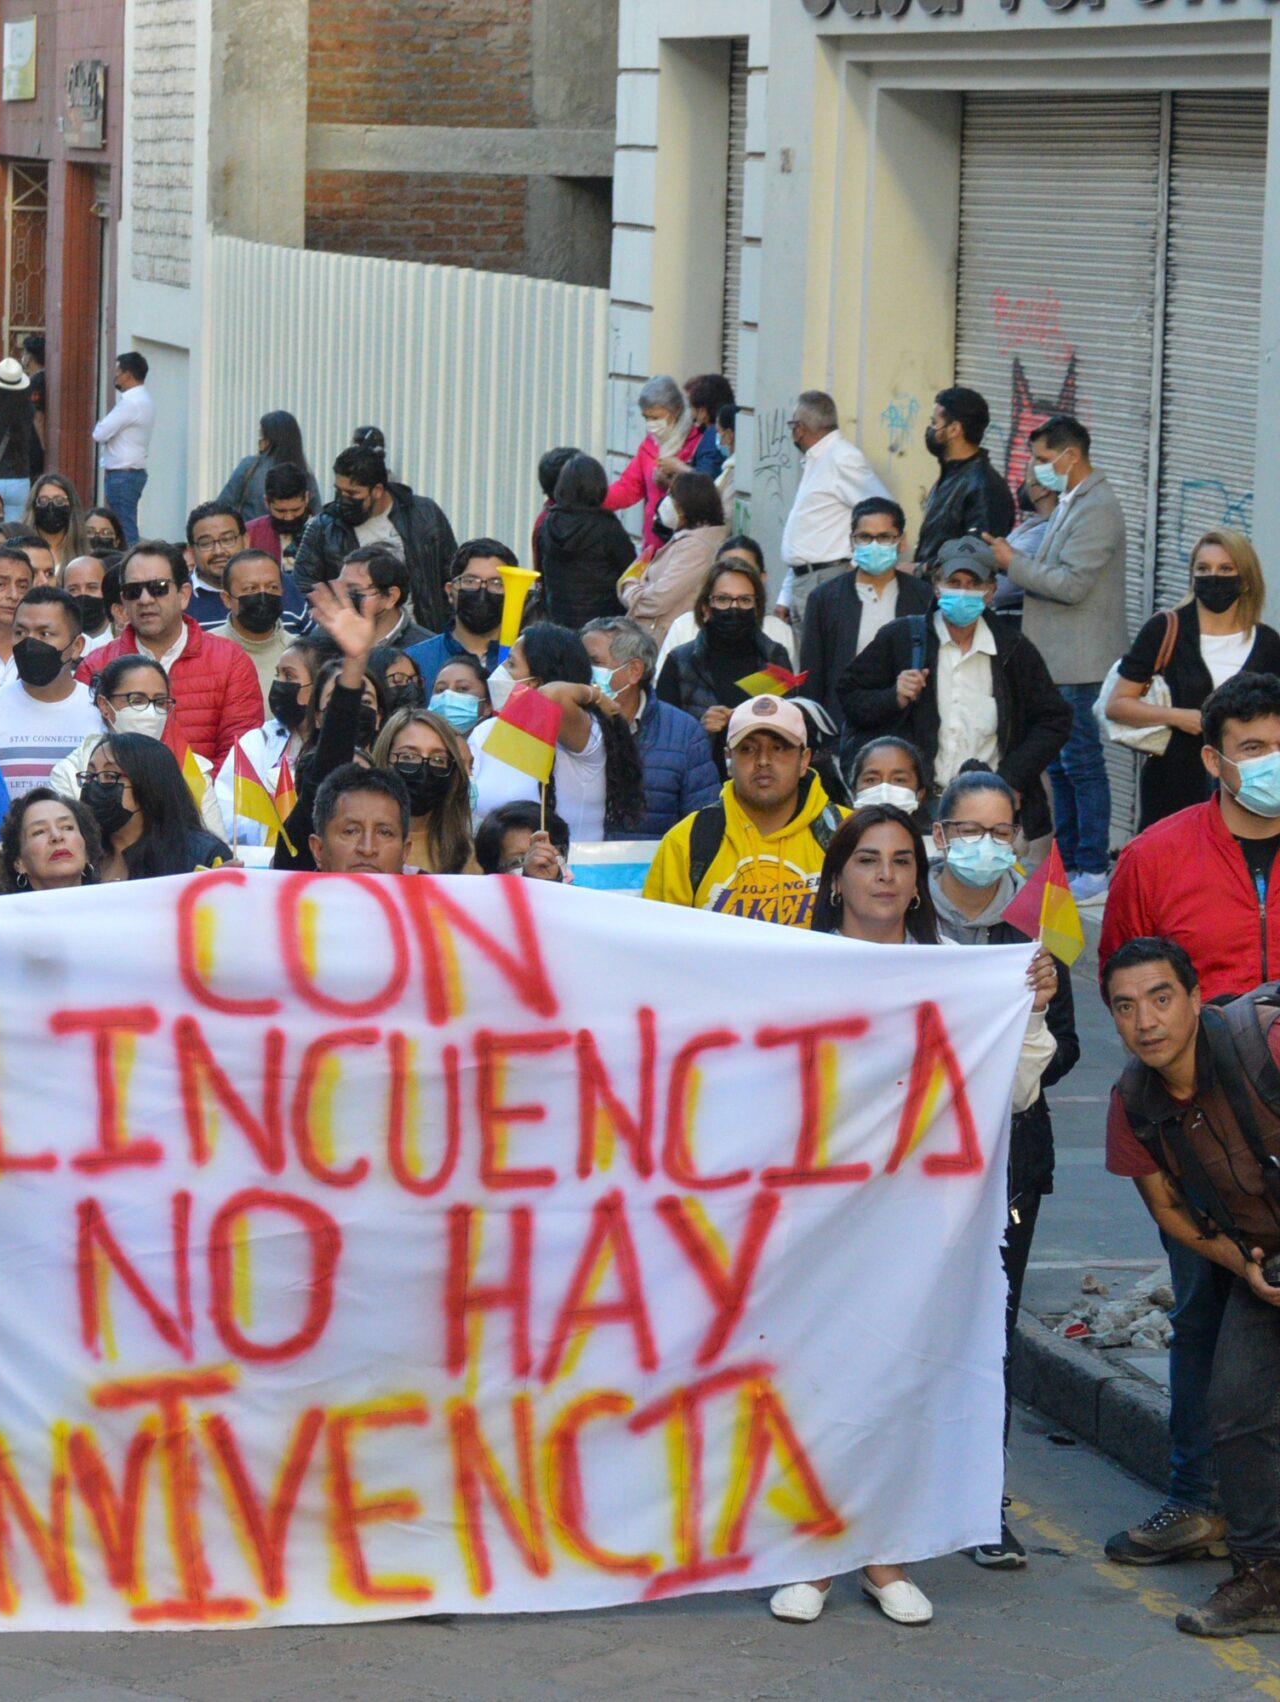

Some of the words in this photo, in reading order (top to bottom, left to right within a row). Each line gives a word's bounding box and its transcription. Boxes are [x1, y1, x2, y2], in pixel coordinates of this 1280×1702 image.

[10, 735, 29, 743] STAY
[178, 868, 558, 1024] CON
[77, 1188, 343, 1363] NO
[442, 1188, 780, 1386] HAY
